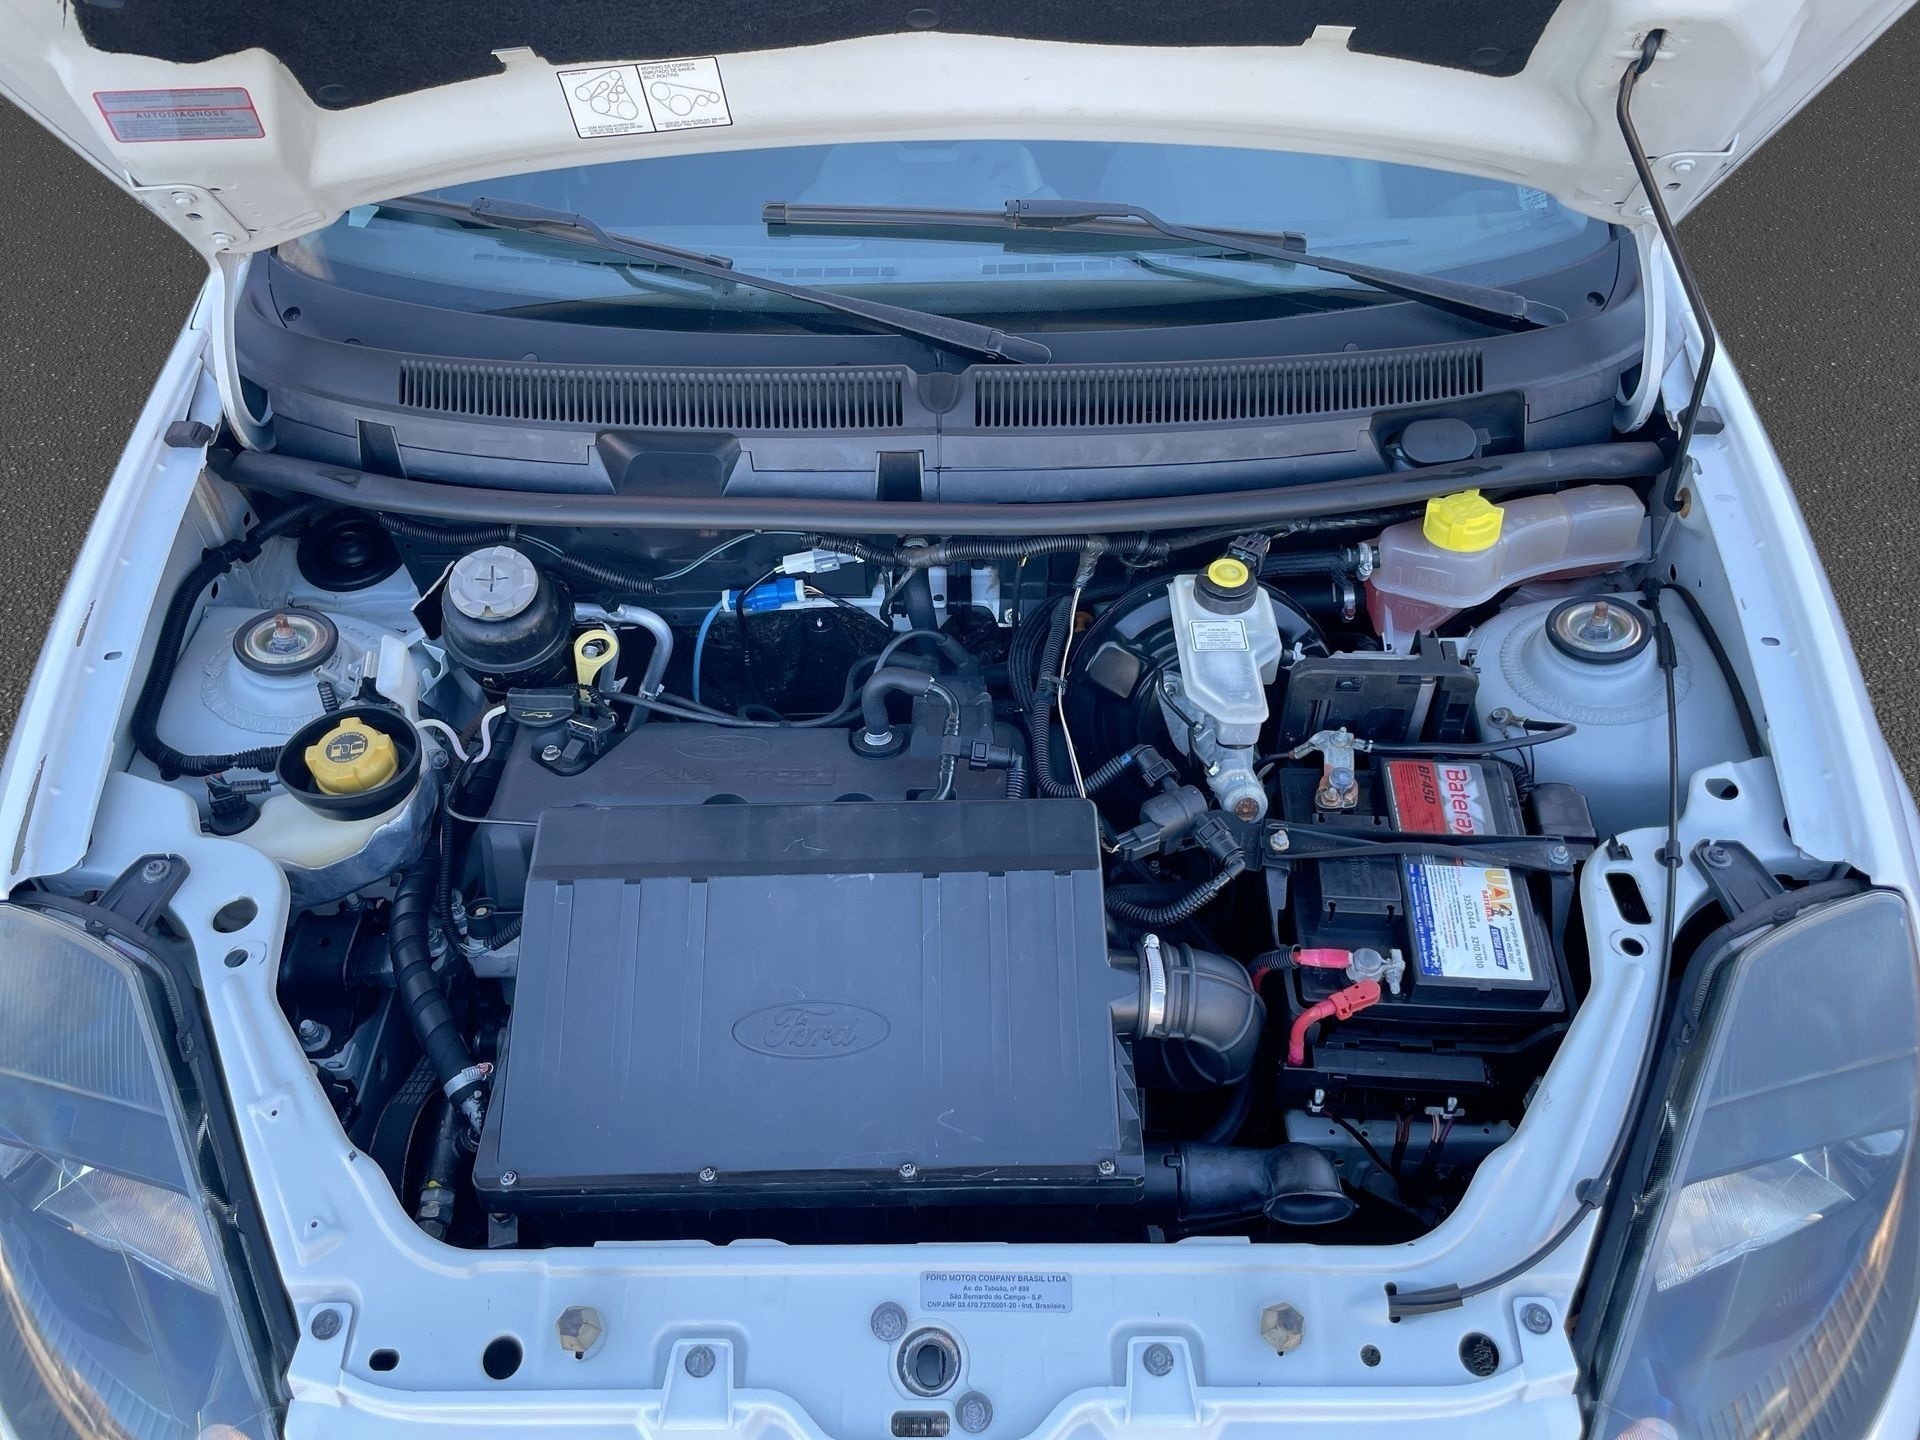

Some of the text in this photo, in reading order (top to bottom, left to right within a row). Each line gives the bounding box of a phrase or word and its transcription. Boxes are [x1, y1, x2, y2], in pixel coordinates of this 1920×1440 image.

[136, 110, 227, 119] AUTODIAGNOSE
[1418, 765, 1436, 805] BF45D
[1482, 890, 1494, 922] BATERIAS
[1464, 894, 1476, 929] 3253.0444
[1471, 936, 1484, 969] 3210.1010
[1491, 928, 1503, 949] ENTREGA
[763, 1008, 860, 1048] Ford
[926, 1273, 1067, 1283] FORD MOTOR COMPANY BRASIL LTDA
[963, 1284, 972, 1292] Av.
[984, 1284, 1009, 1292] Taboão,
[949, 1292, 962, 1300] São
[963, 1292, 993, 1300] Bernardo
[1003, 1293, 1026, 1301] Campo
[1031, 1293, 1043, 1301] S.P.
[957, 1301, 1017, 1309] 03.470.727/0001-20
